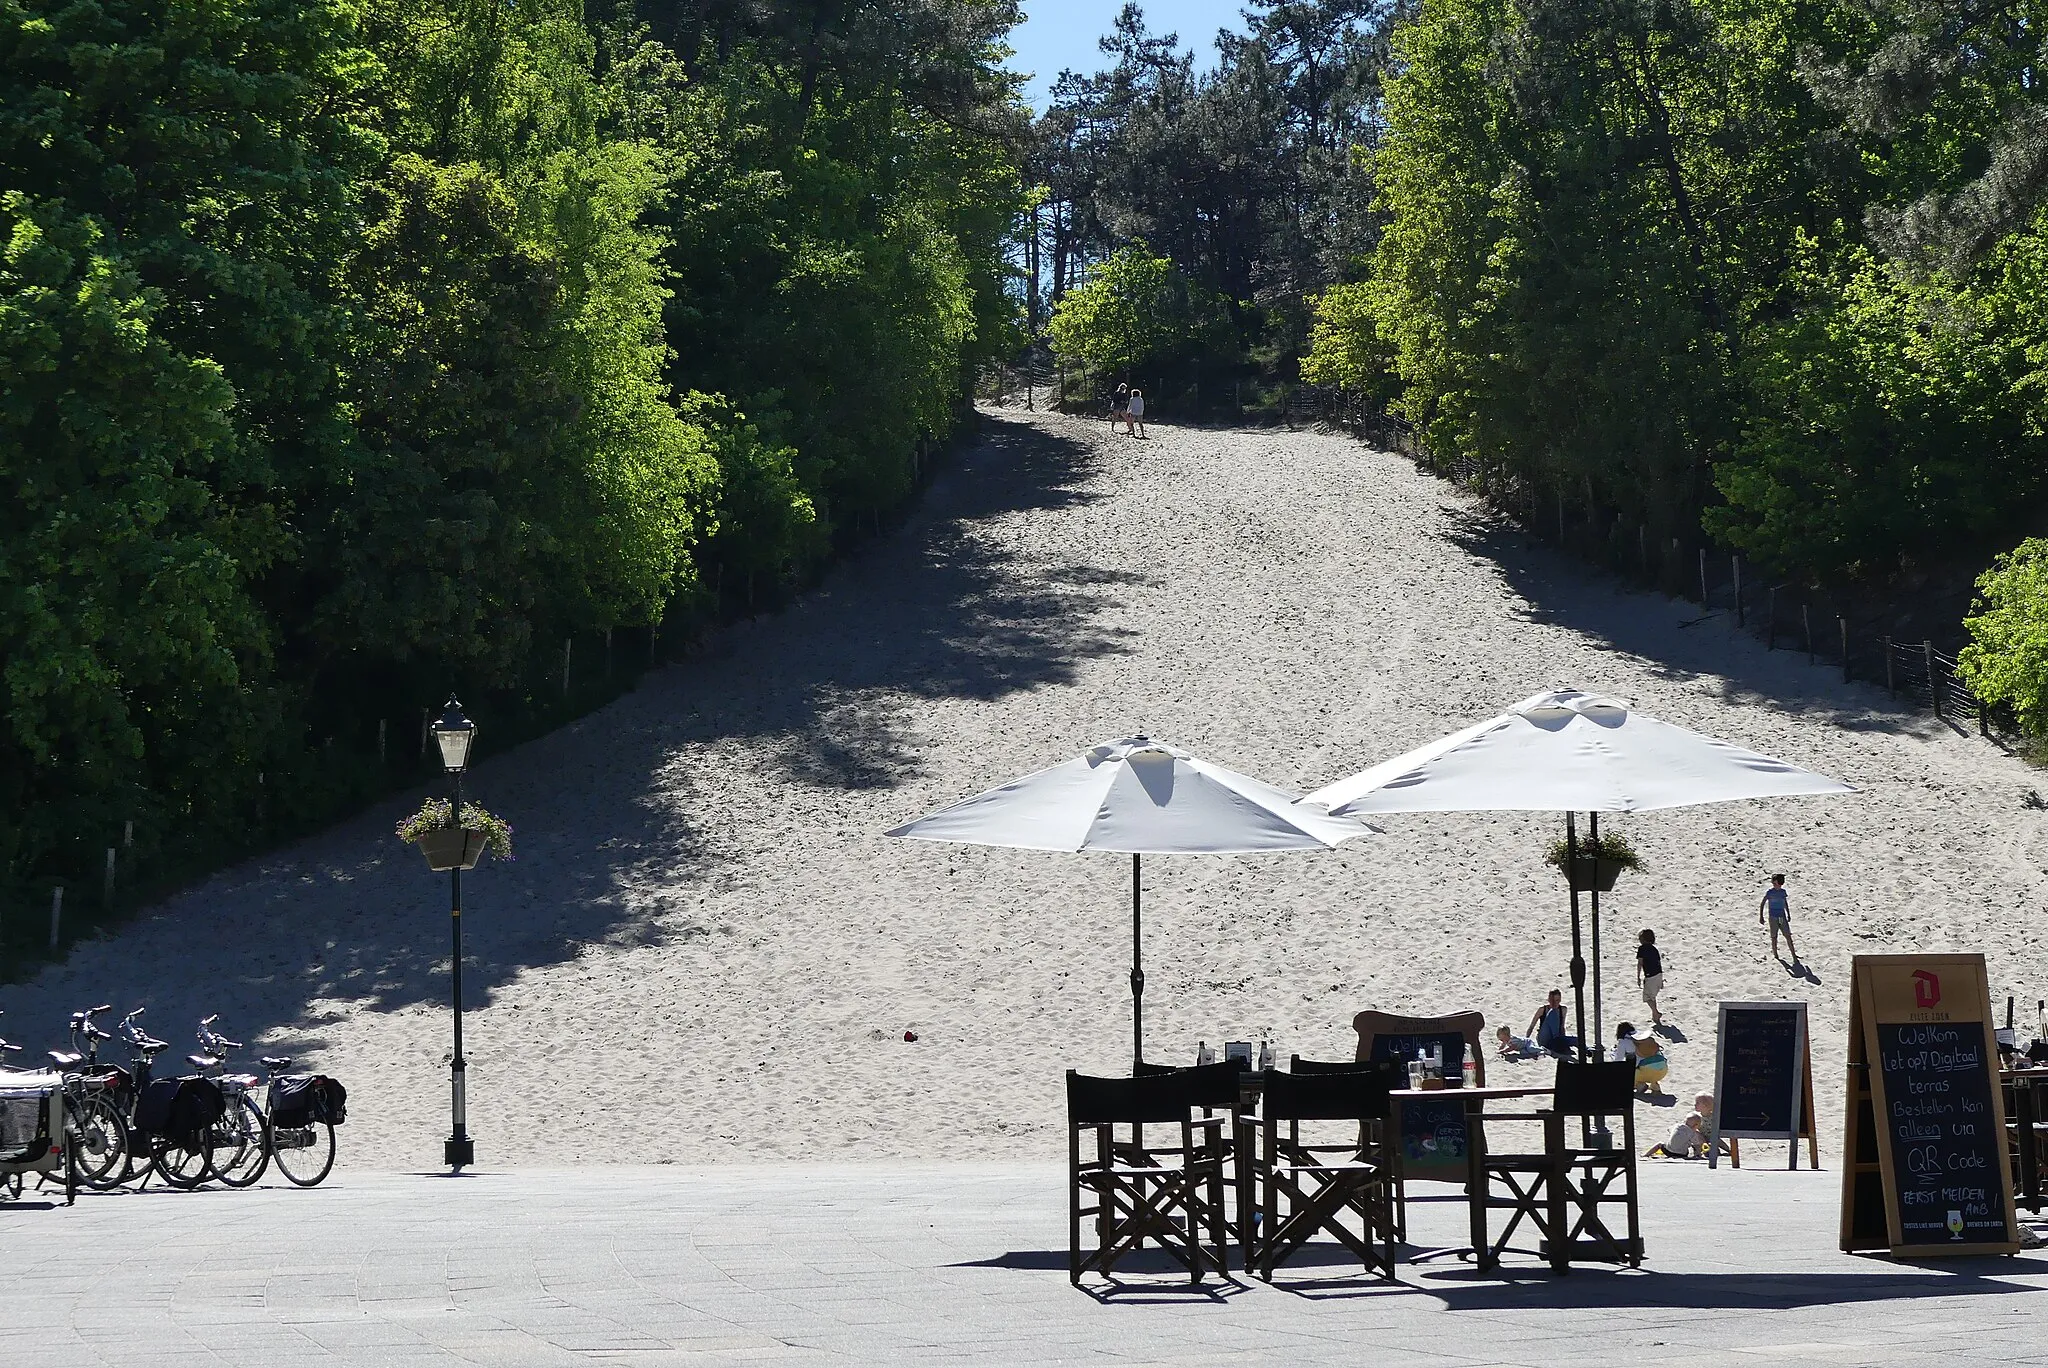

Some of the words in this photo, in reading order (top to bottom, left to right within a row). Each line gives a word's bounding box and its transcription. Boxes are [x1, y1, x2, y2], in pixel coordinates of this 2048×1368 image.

[1898, 1025, 1959, 1046] Welkom
[1882, 1051, 1905, 1071] Let
[1930, 1045, 1979, 1071] Digitaal
[1908, 1075, 1951, 1095] terras
[1893, 1099, 1954, 1118] Bestellen
[1898, 1120, 1942, 1138] alleen
[1952, 1121, 1976, 1137] via
[1907, 1144, 1943, 1173] QR
[1947, 1150, 1988, 1170] Code
[1903, 1189, 1937, 1205] EERST
[1941, 1186, 1985, 1202] MELDEN
